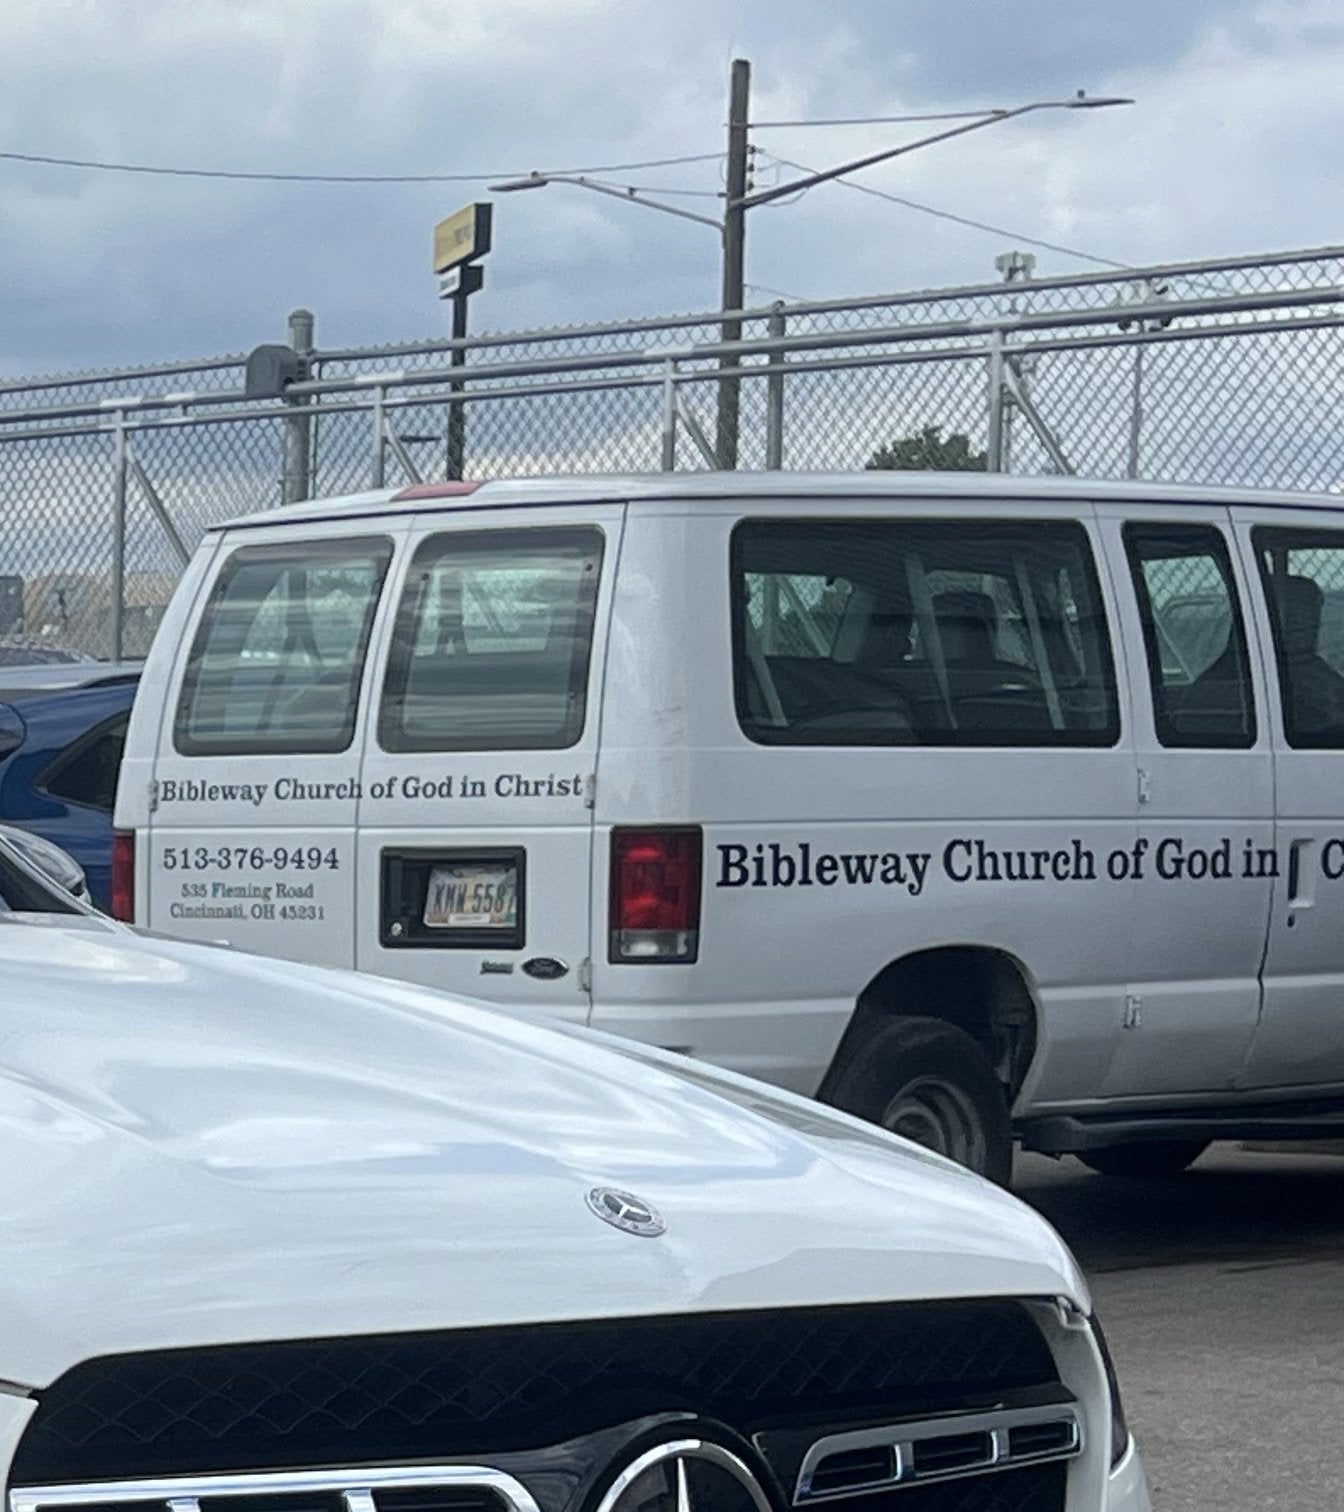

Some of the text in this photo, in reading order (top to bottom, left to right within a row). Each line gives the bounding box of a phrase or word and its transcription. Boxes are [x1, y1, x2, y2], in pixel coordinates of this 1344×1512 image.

[161, 773, 583, 806] Bibleway Church of God in Christ
[163, 847, 339, 870] 513-376-9494
[715, 842, 931, 896] Bibleway
[942, 838, 1097, 882] Church
[1106, 837, 1149, 880] of
[1155, 837, 1233, 880] God
[1241, 838, 1281, 879] in
[211, 881, 273, 901] Fleming
[275, 881, 315, 899] Road
[250, 903, 276, 920] OH
[279, 904, 325, 921] 45231
